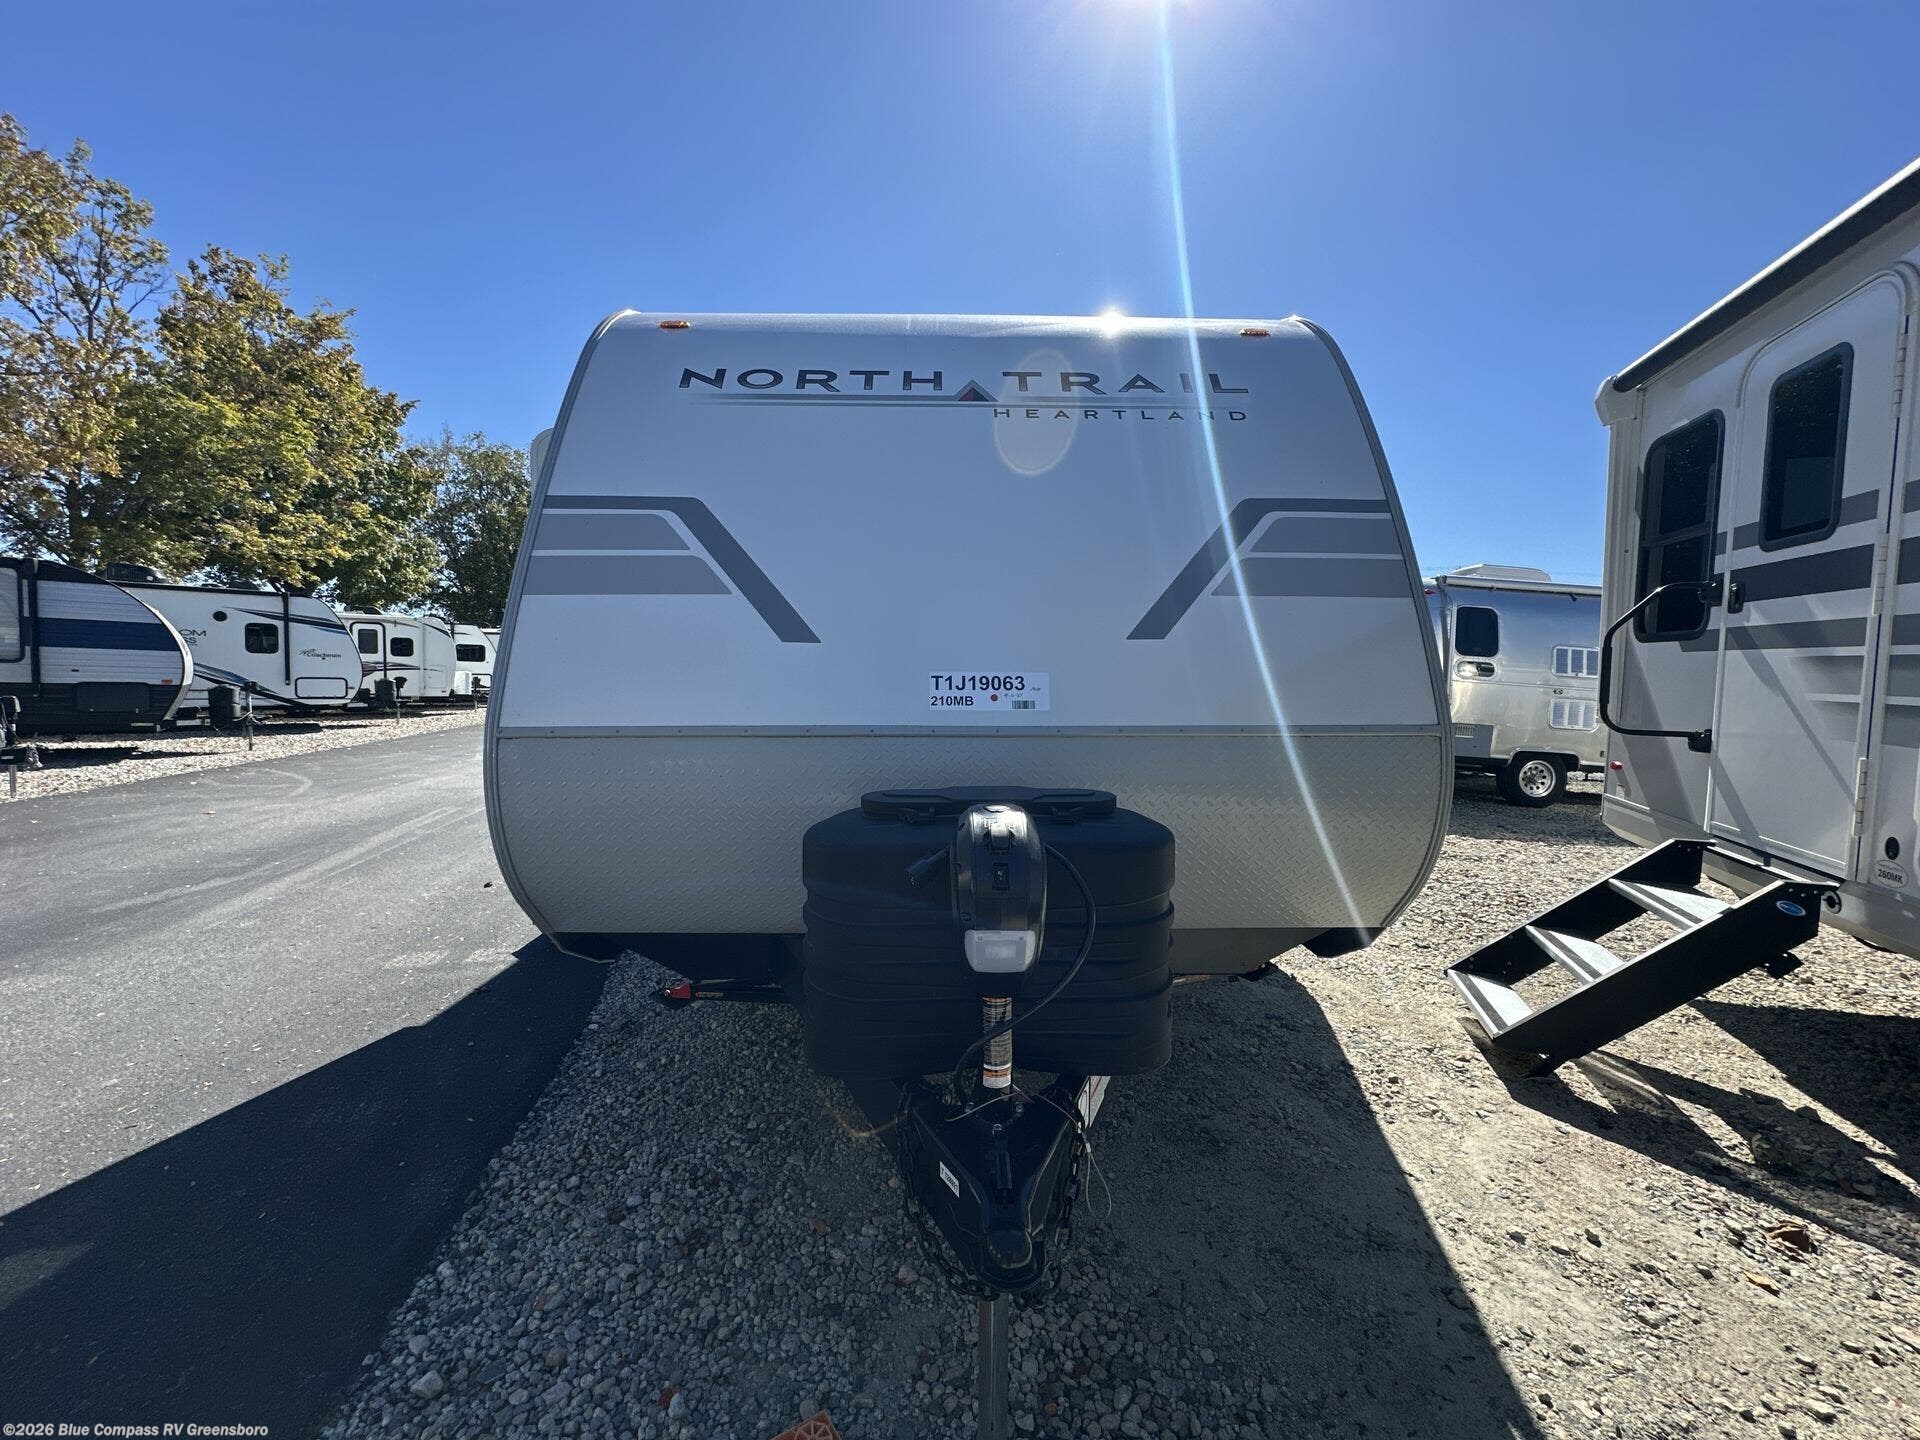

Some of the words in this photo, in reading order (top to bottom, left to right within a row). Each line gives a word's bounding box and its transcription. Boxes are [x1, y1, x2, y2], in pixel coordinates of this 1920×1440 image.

[678, 367, 943, 392] NORTH
[1002, 371, 1249, 395] TRAIL
[993, 408, 1247, 421] HEARTLAND
[930, 675, 1026, 691] T1J19063
[930, 695, 974, 706] 210MB
